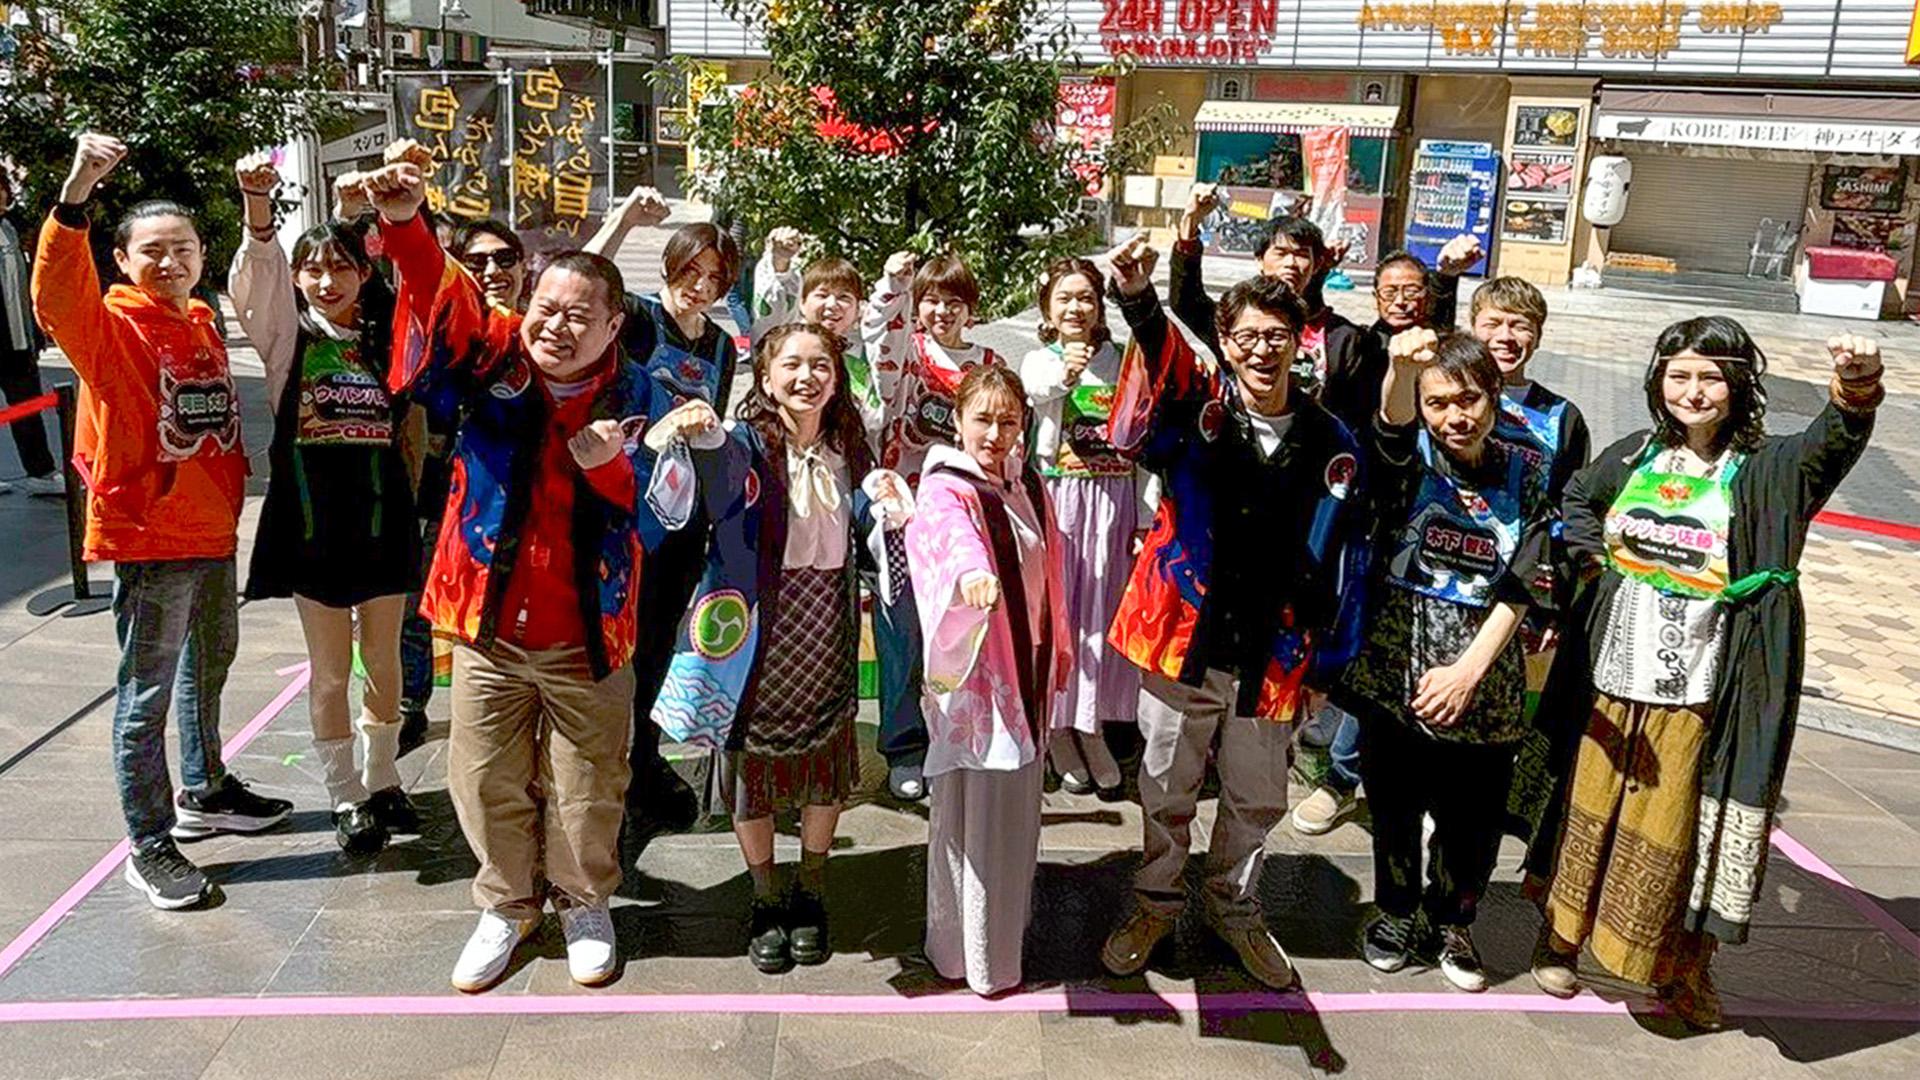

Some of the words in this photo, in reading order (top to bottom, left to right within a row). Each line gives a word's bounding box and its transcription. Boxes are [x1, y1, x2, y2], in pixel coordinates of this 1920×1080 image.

[1099, 0, 1164, 34] 24H
[1177, 0, 1278, 36] OPEN
[1698, 4, 1782, 33] SHOP
[1440, 28, 1497, 56] TAX
[1515, 30, 1588, 57] FREE
[1601, 30, 1680, 59] SHOP
[1669, 121, 1730, 140] KOBE
[1738, 124, 1796, 142] BEEF
[1836, 180, 1893, 194] SASHIMI
[1426, 525, 1462, 552] 木下
